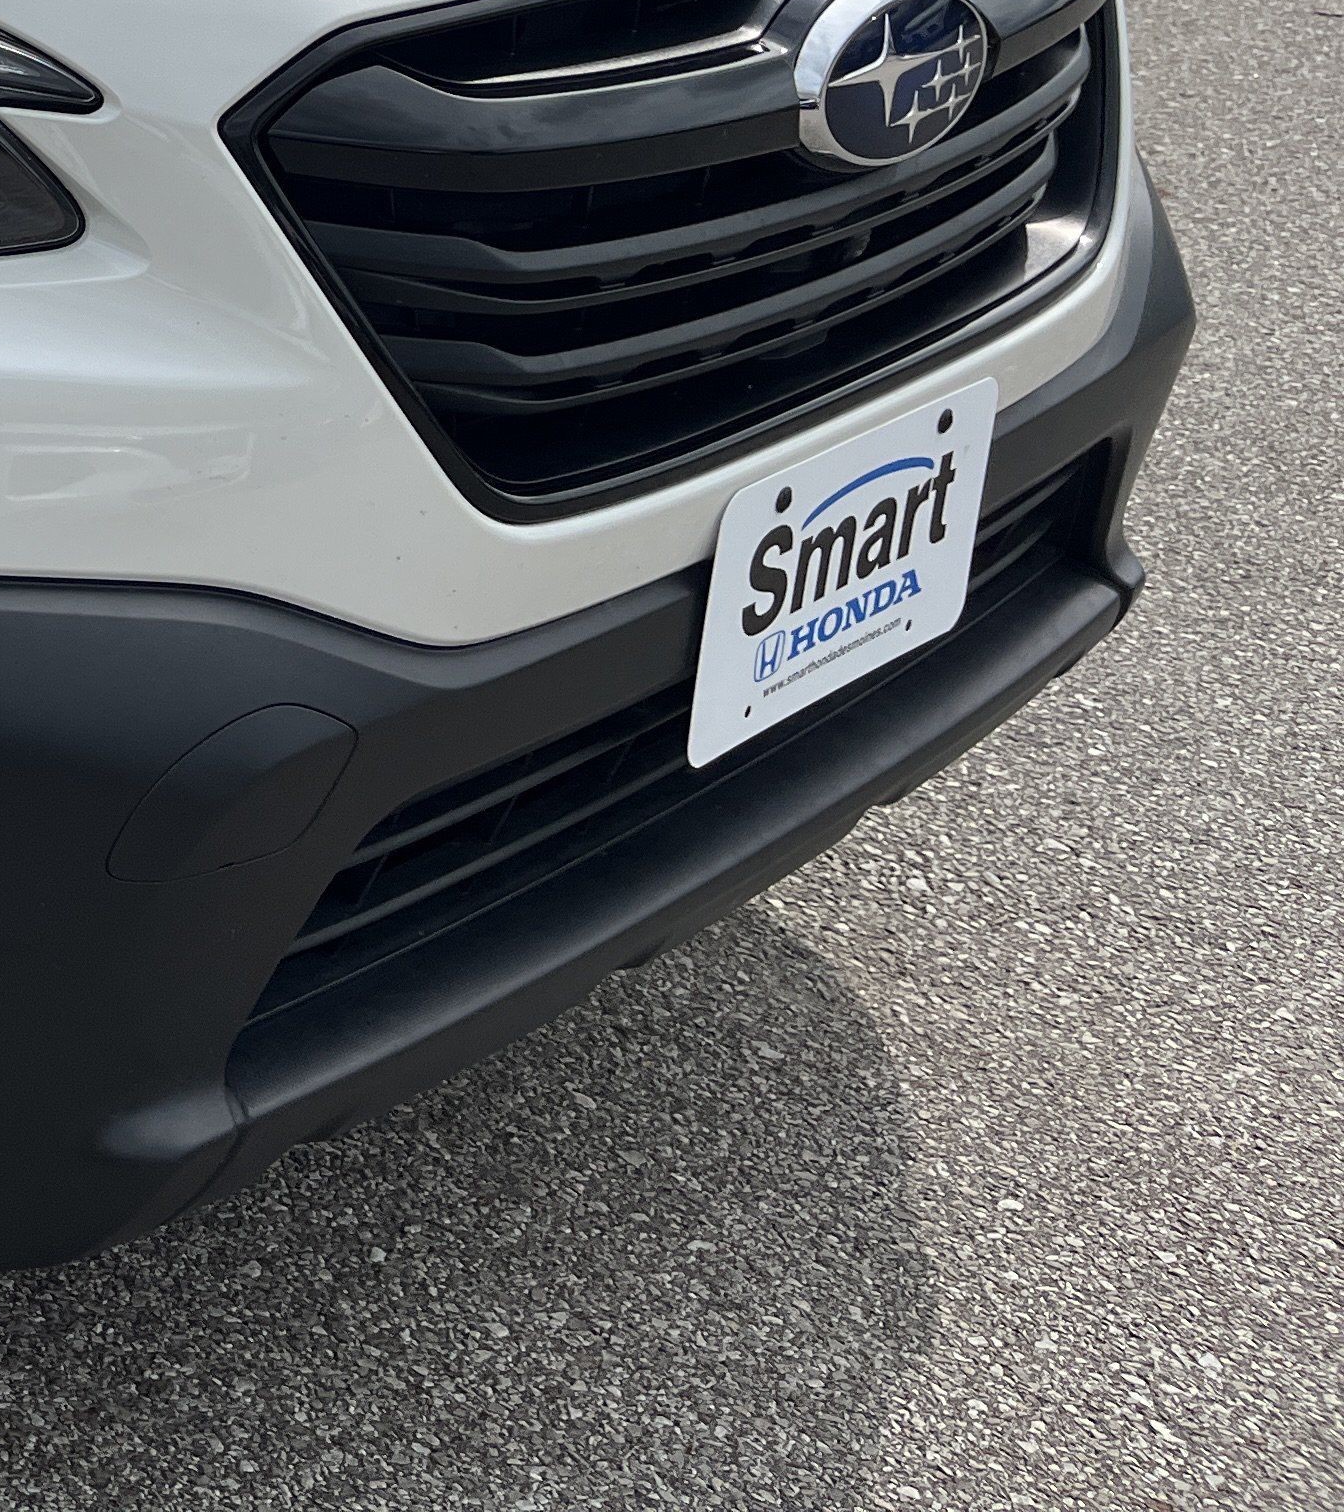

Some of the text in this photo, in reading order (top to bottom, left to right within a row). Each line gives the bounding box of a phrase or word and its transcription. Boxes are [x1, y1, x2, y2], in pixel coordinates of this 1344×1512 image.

[741, 450, 955, 637] Smart
[762, 617, 902, 698] www.smarthondadesmoines.com
[786, 569, 922, 662] HONDA
